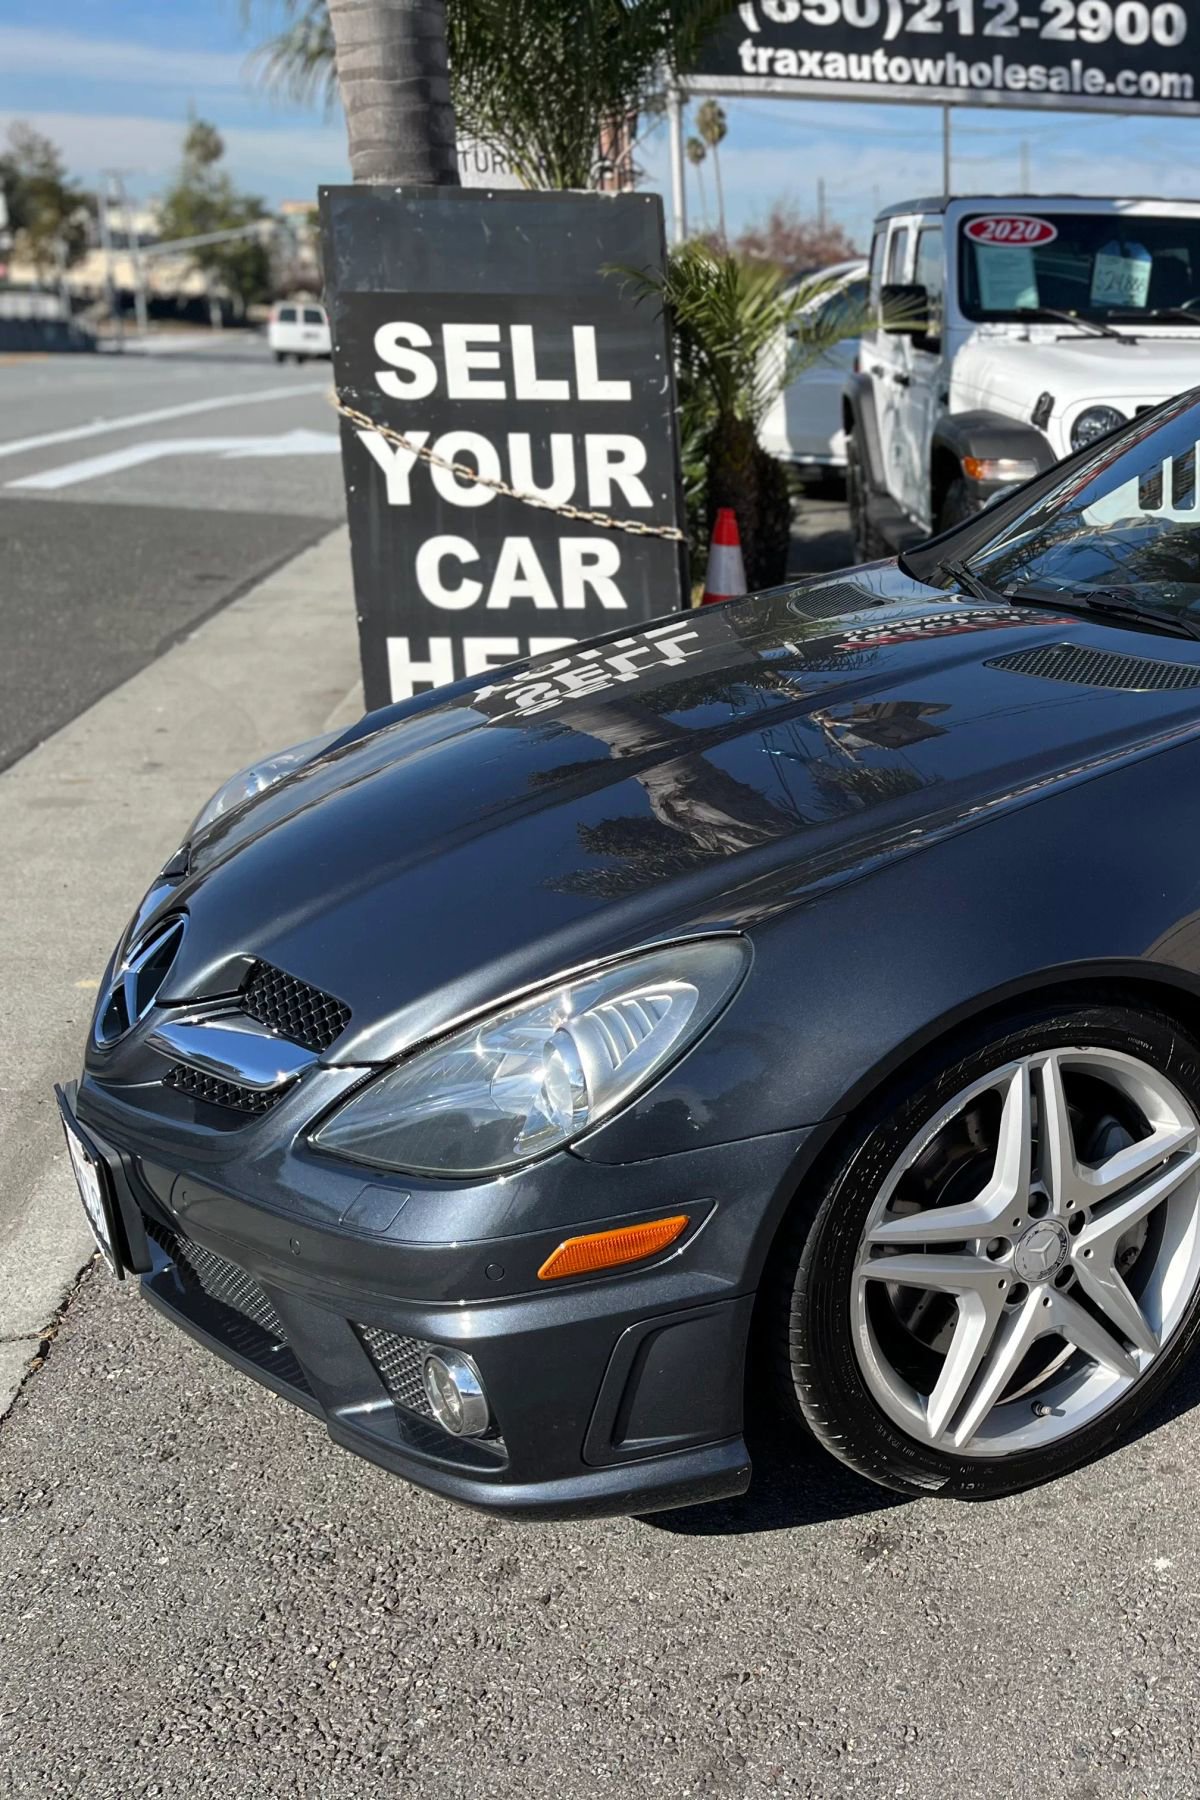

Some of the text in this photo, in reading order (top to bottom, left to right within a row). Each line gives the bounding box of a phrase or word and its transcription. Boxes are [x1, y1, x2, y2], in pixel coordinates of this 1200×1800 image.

[738, 37, 1194, 99] traxautowholesale.com
[979, 220, 1042, 241] 2020
[373, 321, 632, 401] SELL
[357, 430, 654, 508] YOUR
[415, 535, 628, 610] CAR
[386, 637, 580, 704] HE
